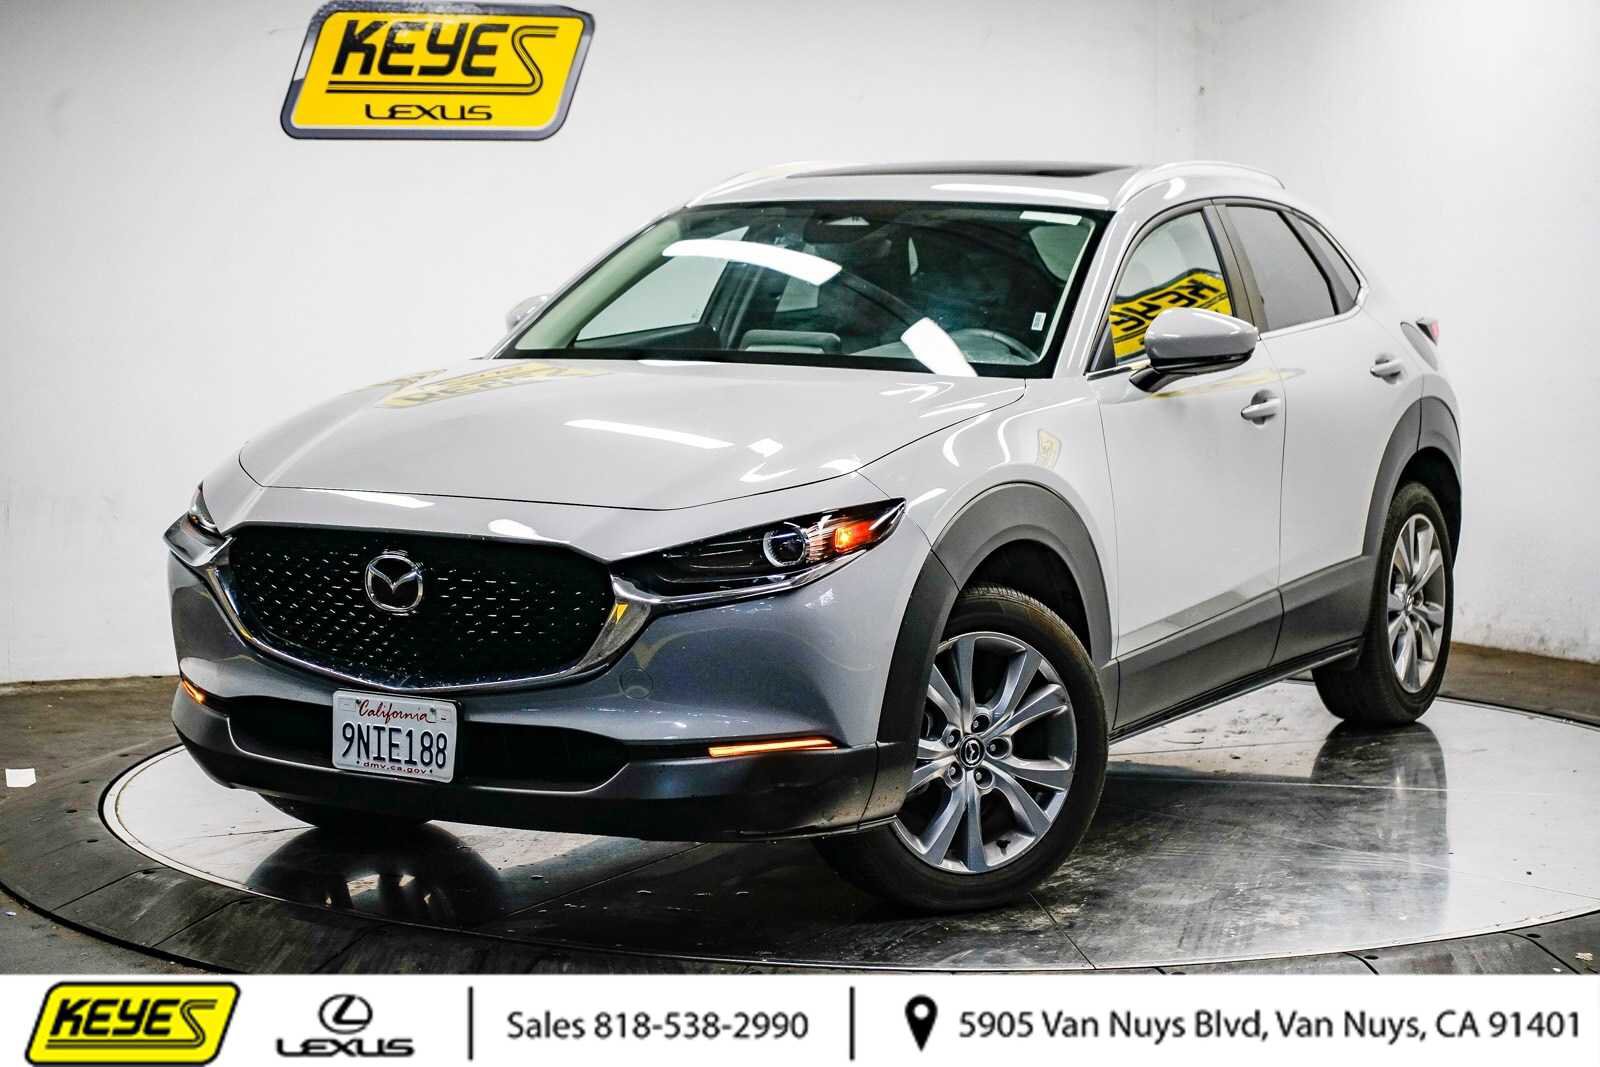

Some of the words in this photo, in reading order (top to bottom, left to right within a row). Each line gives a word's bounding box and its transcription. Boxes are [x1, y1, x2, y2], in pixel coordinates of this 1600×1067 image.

[327, 19, 559, 95] KEYES
[365, 104, 493, 121] LEXUS
[359, 699, 437, 724] California
[342, 722, 448, 769] 9NIE188
[363, 761, 427, 775] dmv.ca.gov
